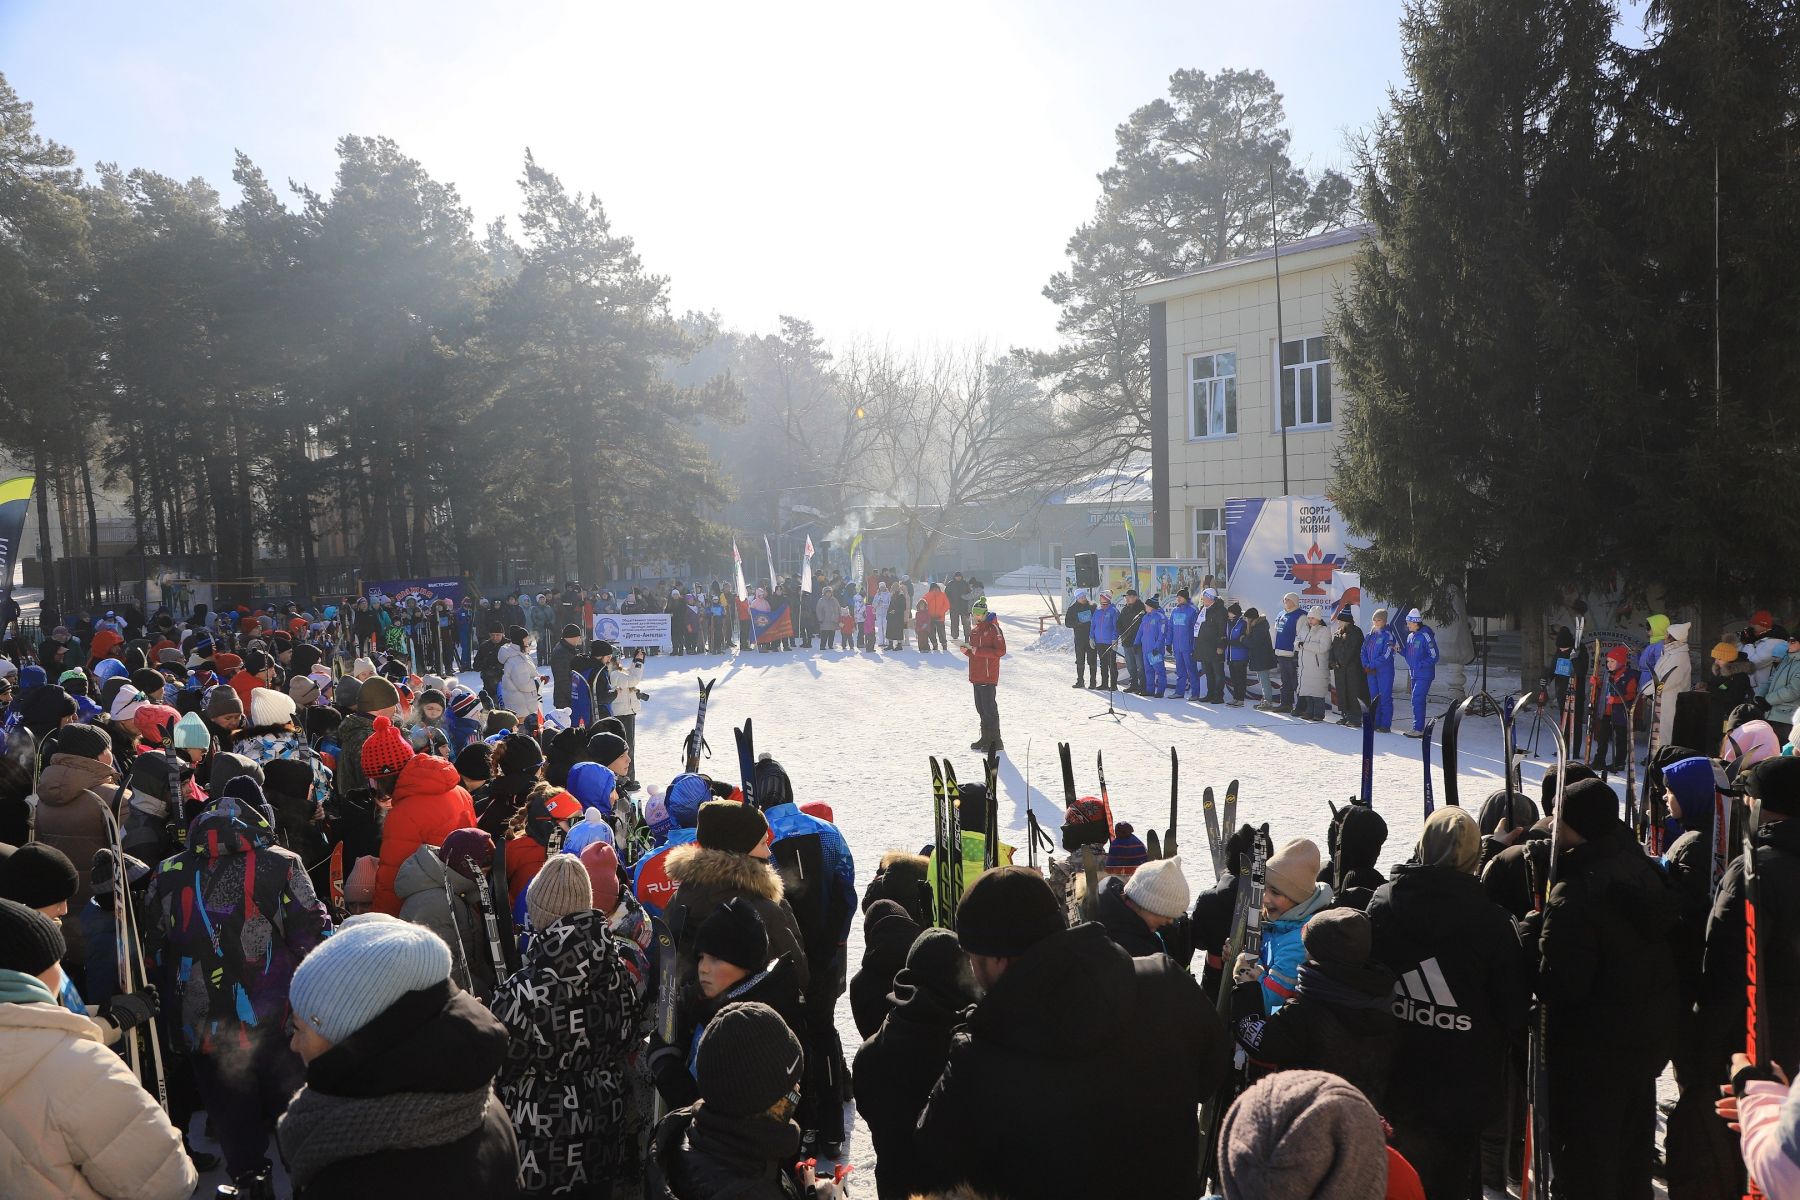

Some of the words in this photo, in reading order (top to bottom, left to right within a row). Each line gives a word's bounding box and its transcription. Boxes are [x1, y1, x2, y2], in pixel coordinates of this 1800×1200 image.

[1300, 515, 1330, 524] НОРМА
[1300, 525, 1330, 533] ЖИЗНИ
[940, 798, 948, 850] FISCHER
[1745, 899, 1758, 1067] BRADOS
[1391, 998, 1472, 1031] didas
[158, 1079, 167, 1101] TISA
